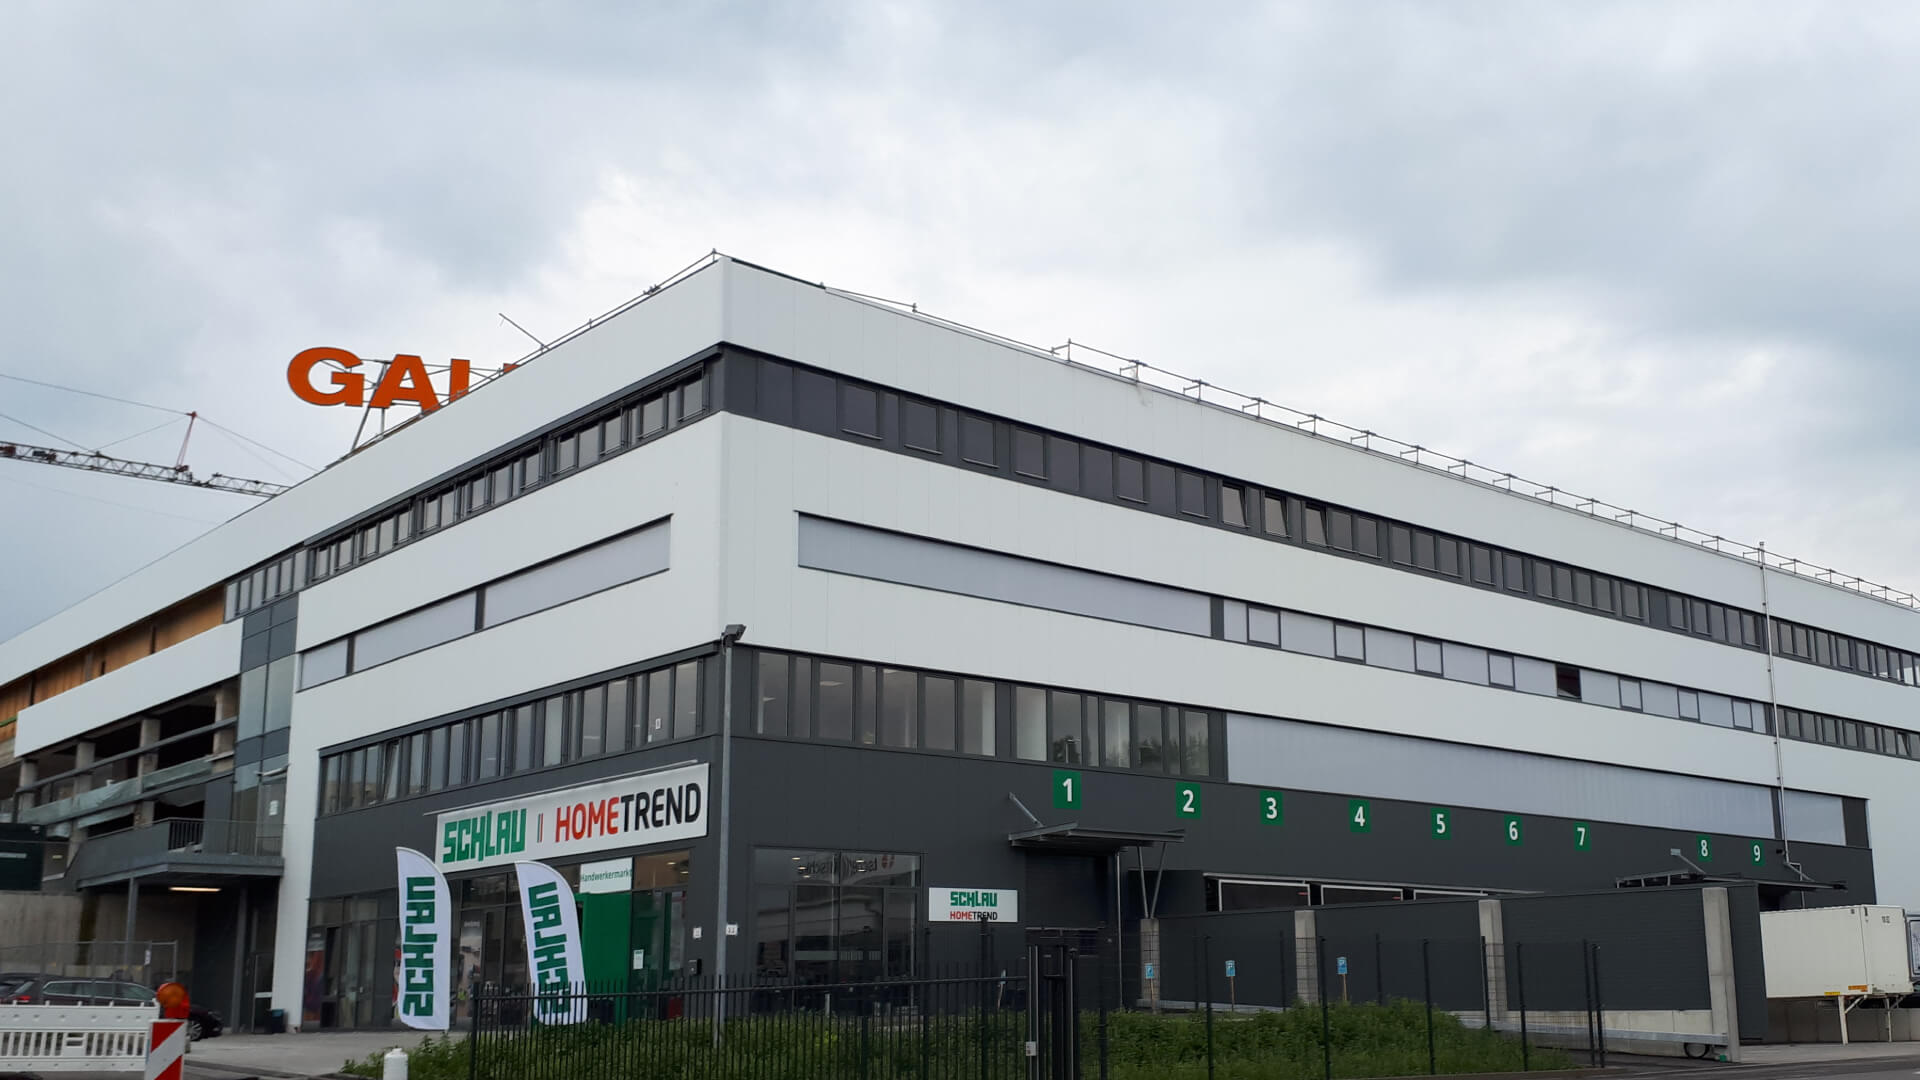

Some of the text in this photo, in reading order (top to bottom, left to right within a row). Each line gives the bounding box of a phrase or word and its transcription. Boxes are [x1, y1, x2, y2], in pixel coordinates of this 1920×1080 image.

[1062, 779, 1073, 802] 1
[1182, 790, 1195, 813] 2
[1266, 798, 1278, 820] 3
[442, 782, 702, 864] SCHLAU HOMETREND
[1354, 807, 1366, 827] 4
[1436, 814, 1446, 834] 5
[1509, 822, 1519, 841] 6
[1577, 828, 1586, 846] 7
[1700, 840, 1709, 857] 8
[1753, 845, 1761, 862] 9
[950, 890, 998, 908] SCHLAU
